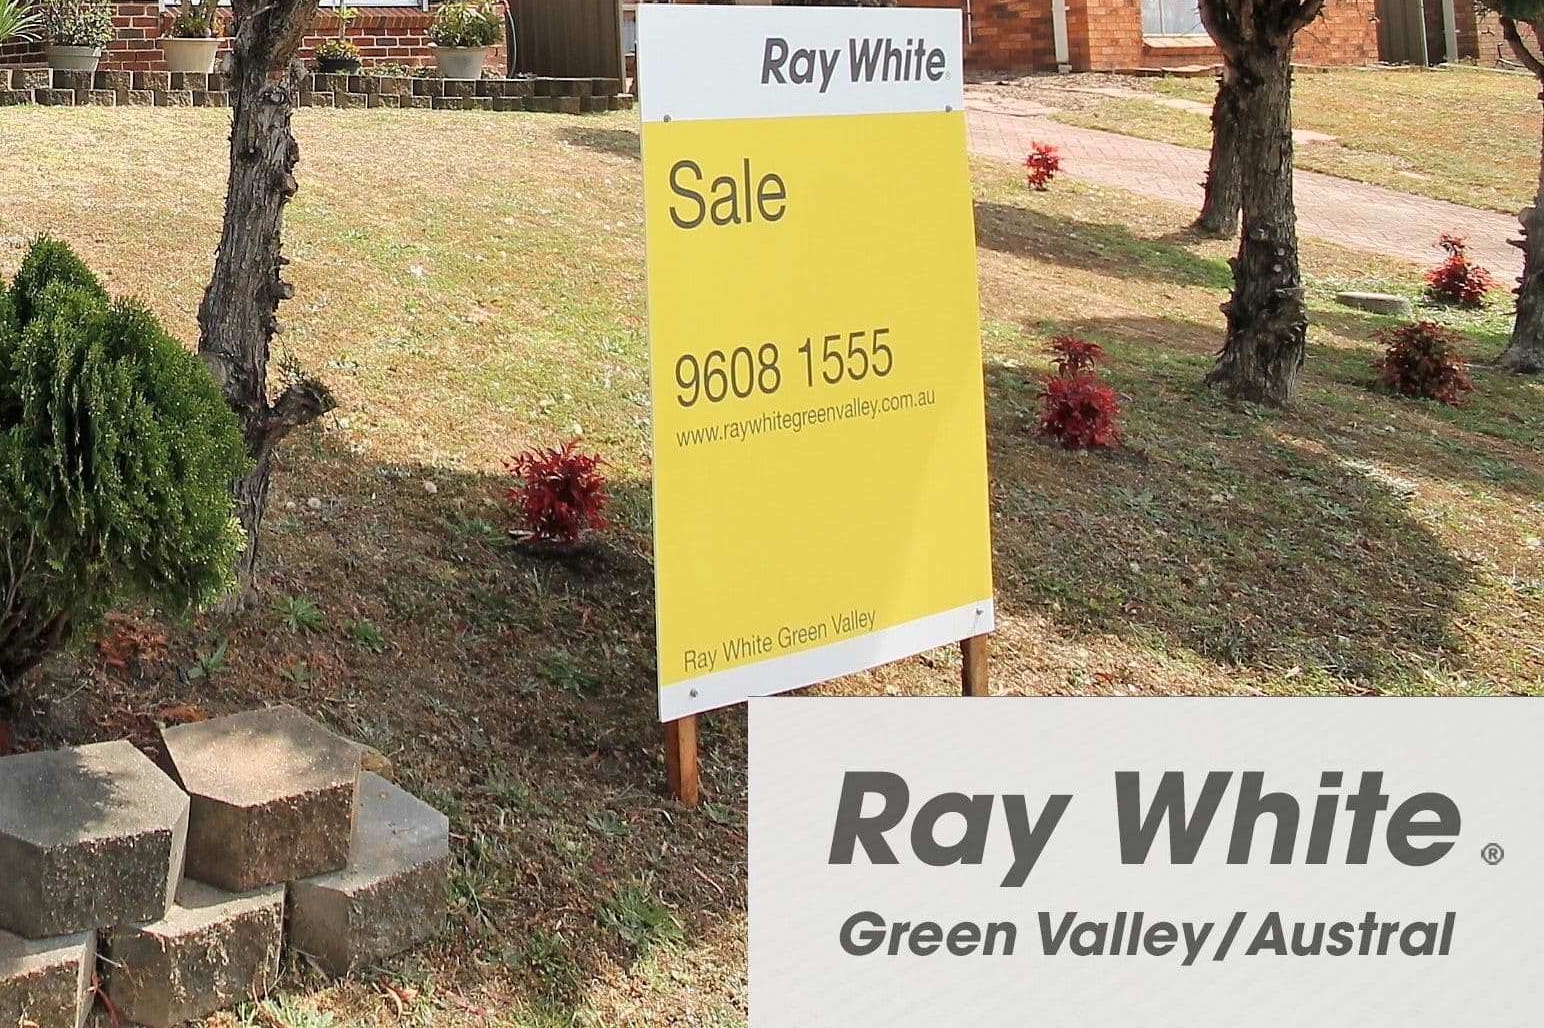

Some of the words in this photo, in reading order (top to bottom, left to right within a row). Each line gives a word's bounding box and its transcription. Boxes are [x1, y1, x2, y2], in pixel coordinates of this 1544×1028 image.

[761, 38, 841, 93] Ray
[849, 38, 946, 83] White
[668, 158, 787, 230] Sale
[675, 343, 781, 407] 9608
[798, 328, 893, 387] 1555
[676, 389, 936, 447] www.raywhitegreenvalley.com.au
[684, 649, 718, 672] Ray
[723, 634, 773, 662] White
[778, 622, 827, 649] Green
[831, 609, 876, 632] Valley
